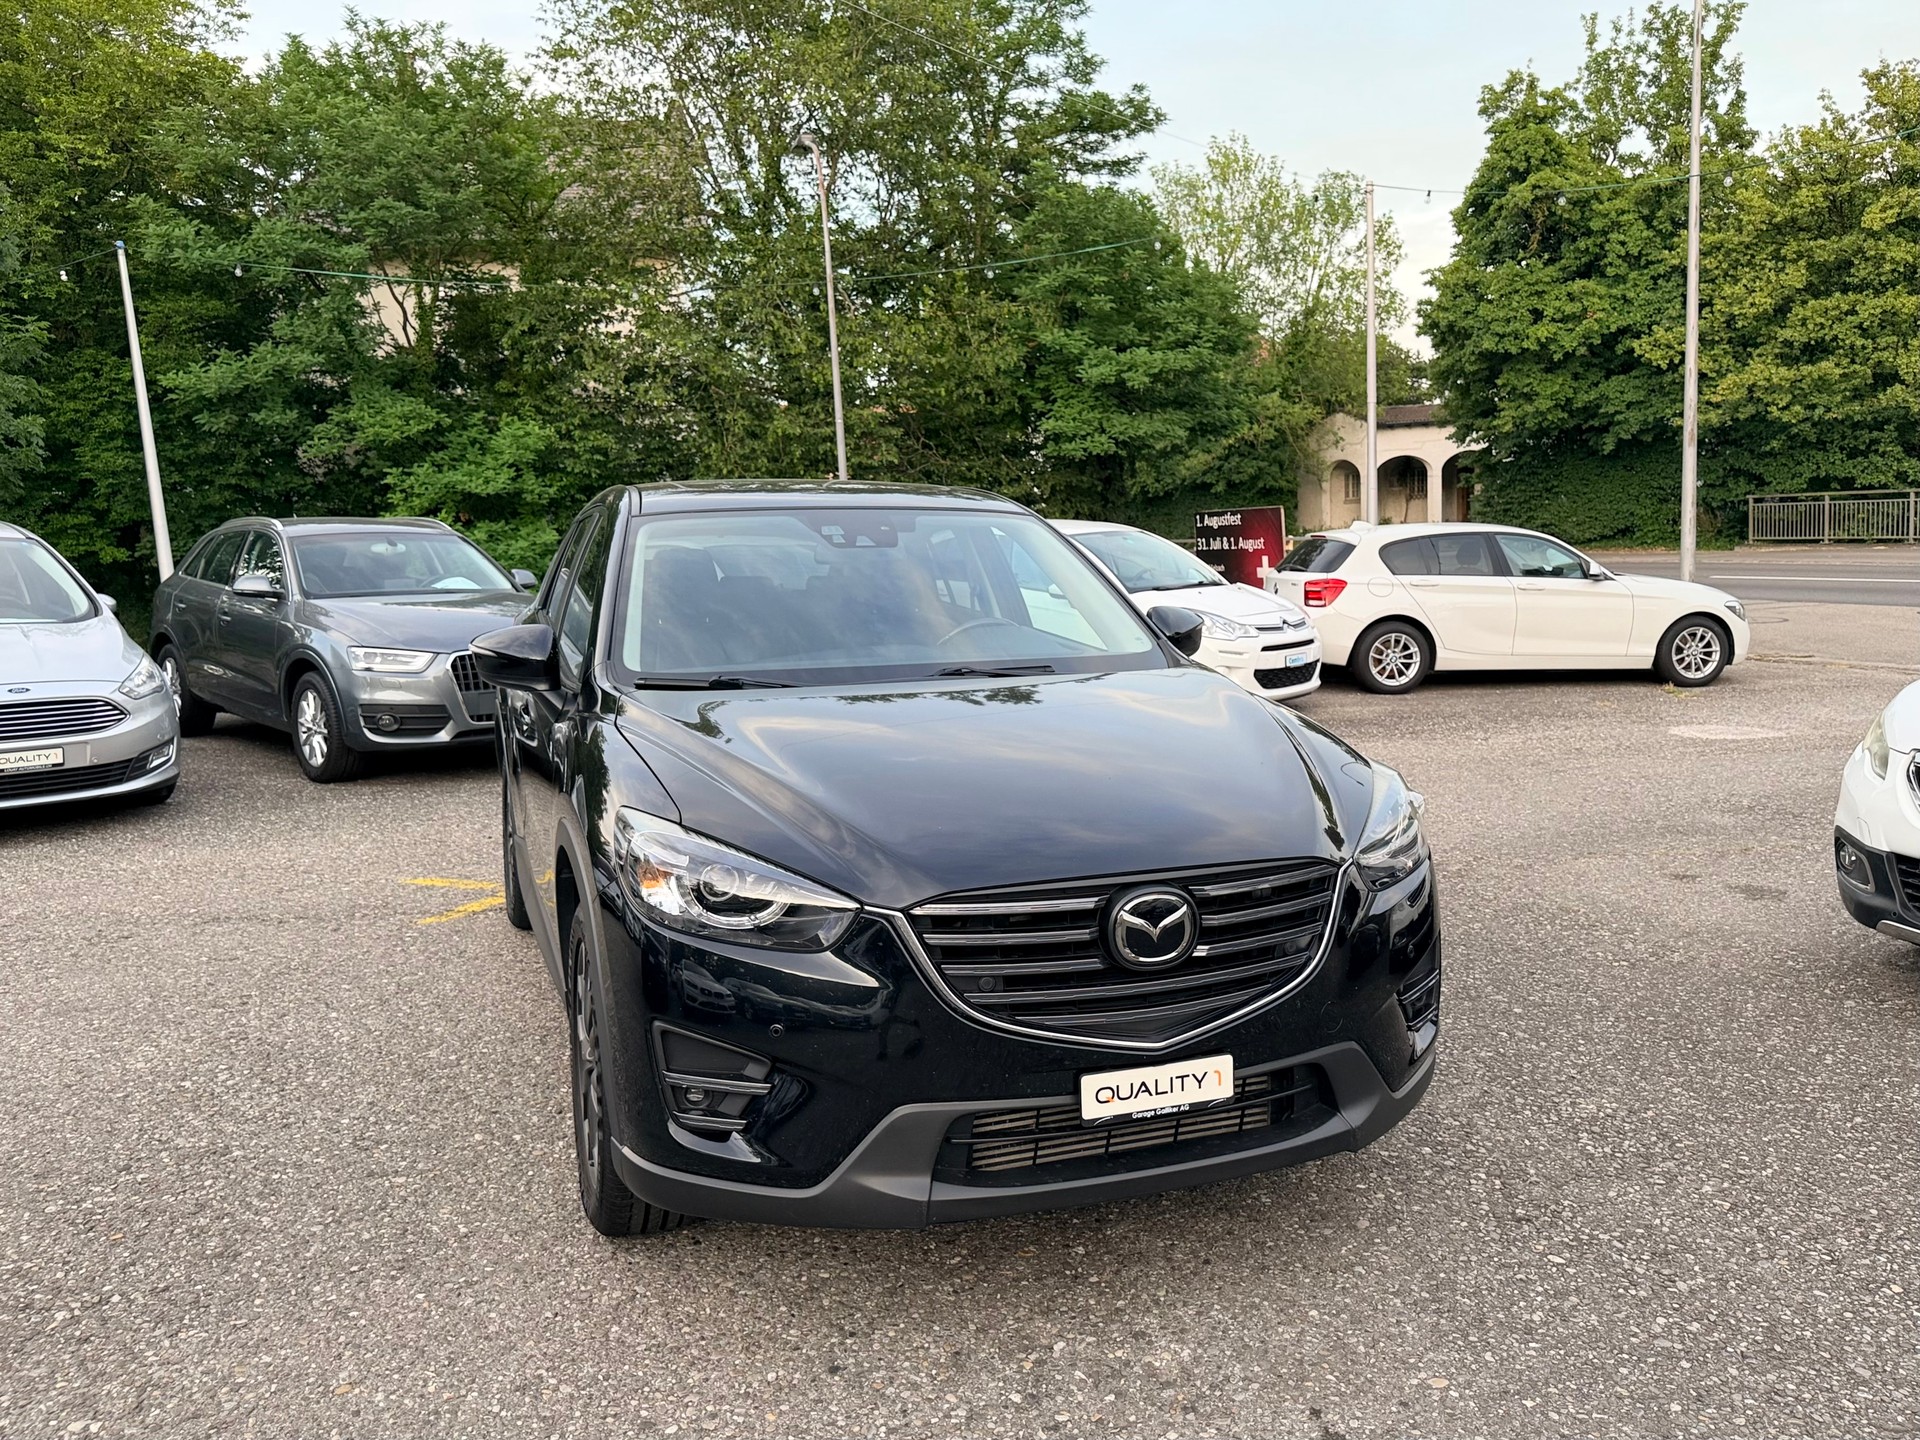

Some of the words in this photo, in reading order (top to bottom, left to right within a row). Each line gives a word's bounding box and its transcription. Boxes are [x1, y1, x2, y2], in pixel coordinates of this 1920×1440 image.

[1196, 514, 1203, 527] 1.
[1204, 511, 1242, 529] Augustfest
[1197, 537, 1209, 551] 31.
[1210, 536, 1222, 551] Juli
[1222, 536, 1230, 550] &
[1230, 536, 1238, 550] 1.
[1238, 536, 1265, 552] August
[1095, 1071, 1208, 1104] QUALITY
[1213, 1069, 1222, 1087] 1
[1131, 1110, 1155, 1119] Garage
[1155, 1106, 1179, 1115] Galliker
[1179, 1103, 1190, 1112] AG
